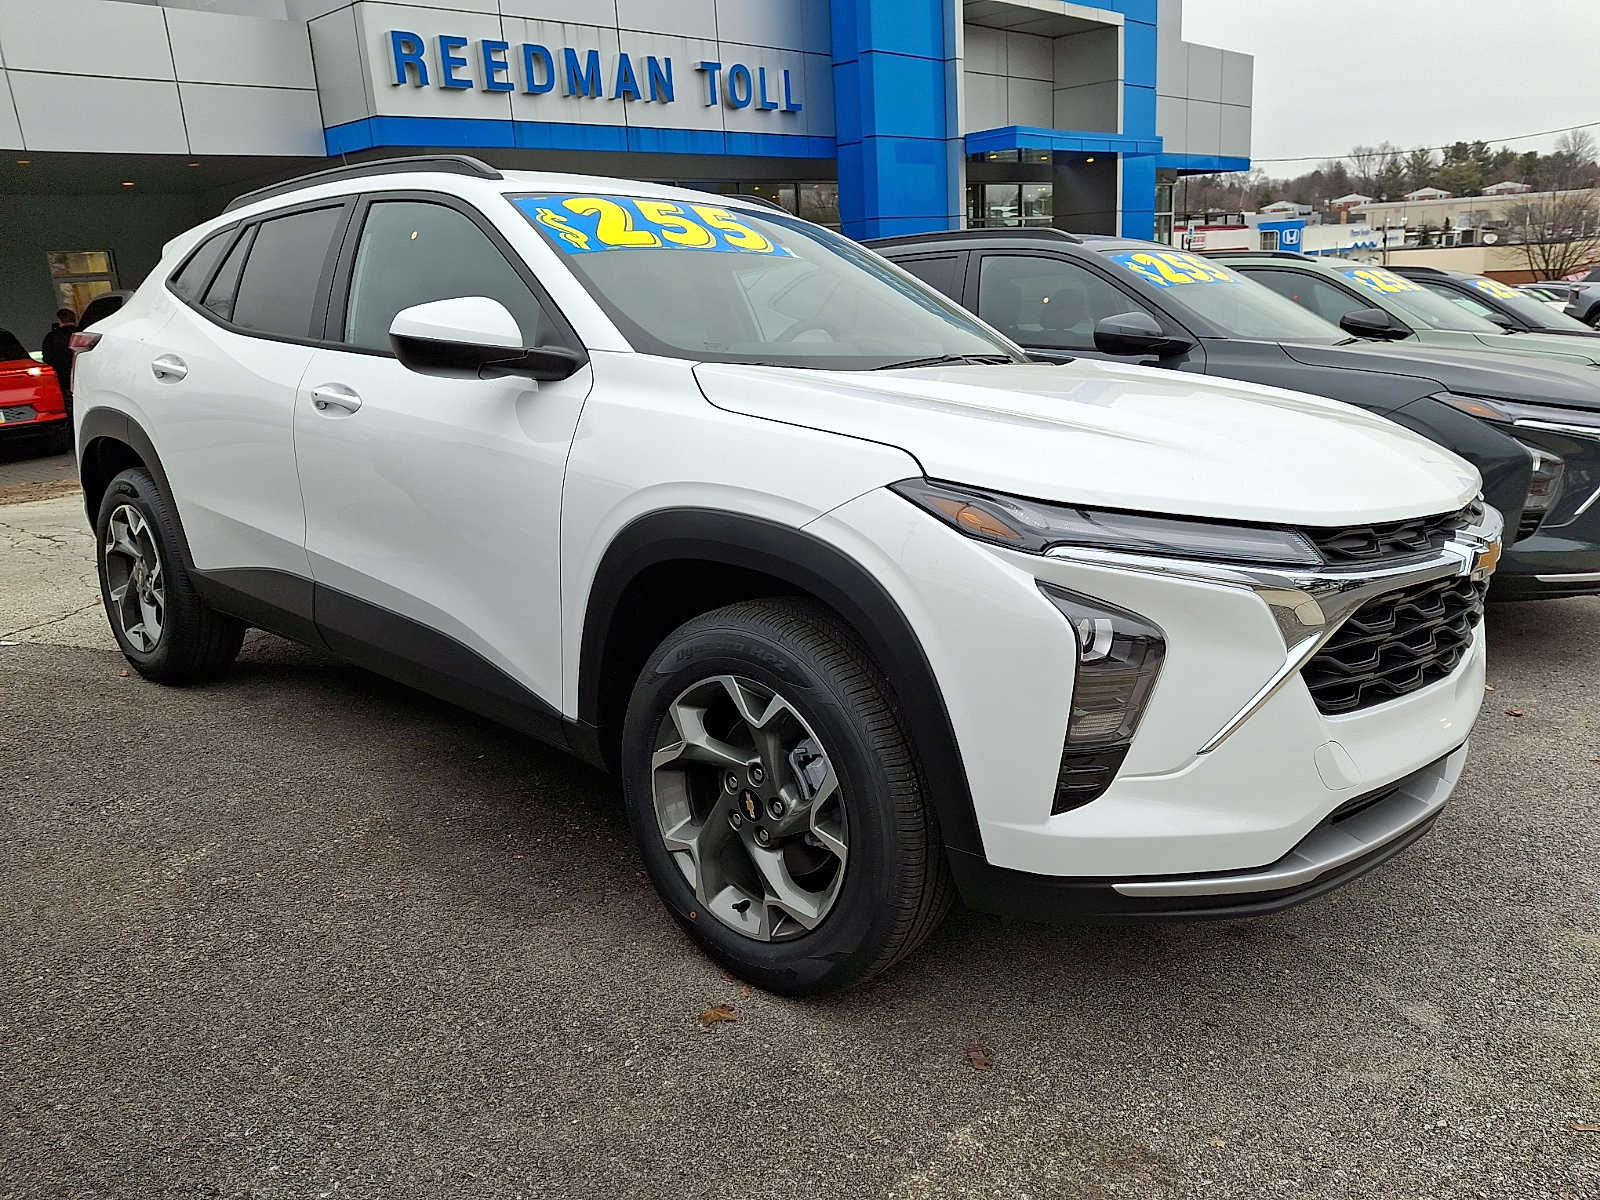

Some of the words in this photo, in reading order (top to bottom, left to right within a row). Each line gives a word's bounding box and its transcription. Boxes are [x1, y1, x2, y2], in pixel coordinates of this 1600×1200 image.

[390, 31, 675, 103] REEDMAN
[695, 61, 803, 112] TOLL
[535, 198, 775, 252] $255
[1124, 253, 1234, 287] $255
